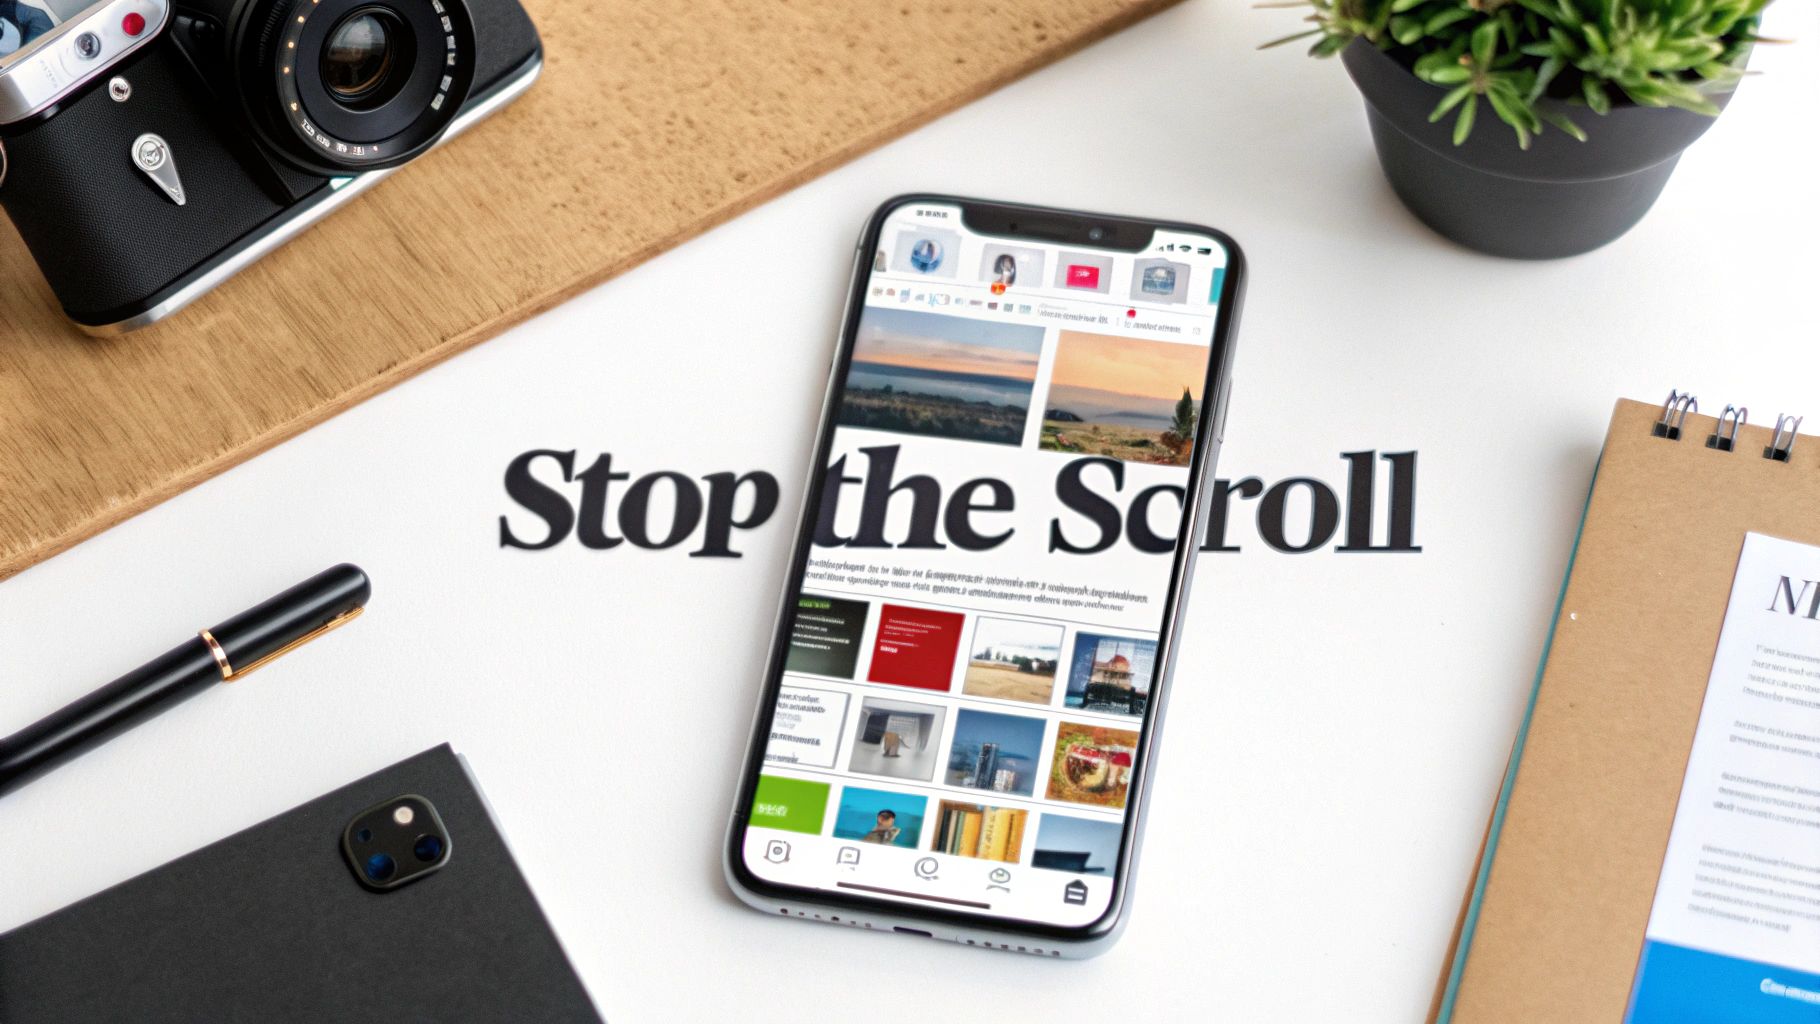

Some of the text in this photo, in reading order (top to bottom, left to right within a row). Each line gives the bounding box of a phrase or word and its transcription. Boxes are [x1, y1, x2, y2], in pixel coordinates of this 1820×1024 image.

[498, 443, 1423, 559] Stop the Scroll
